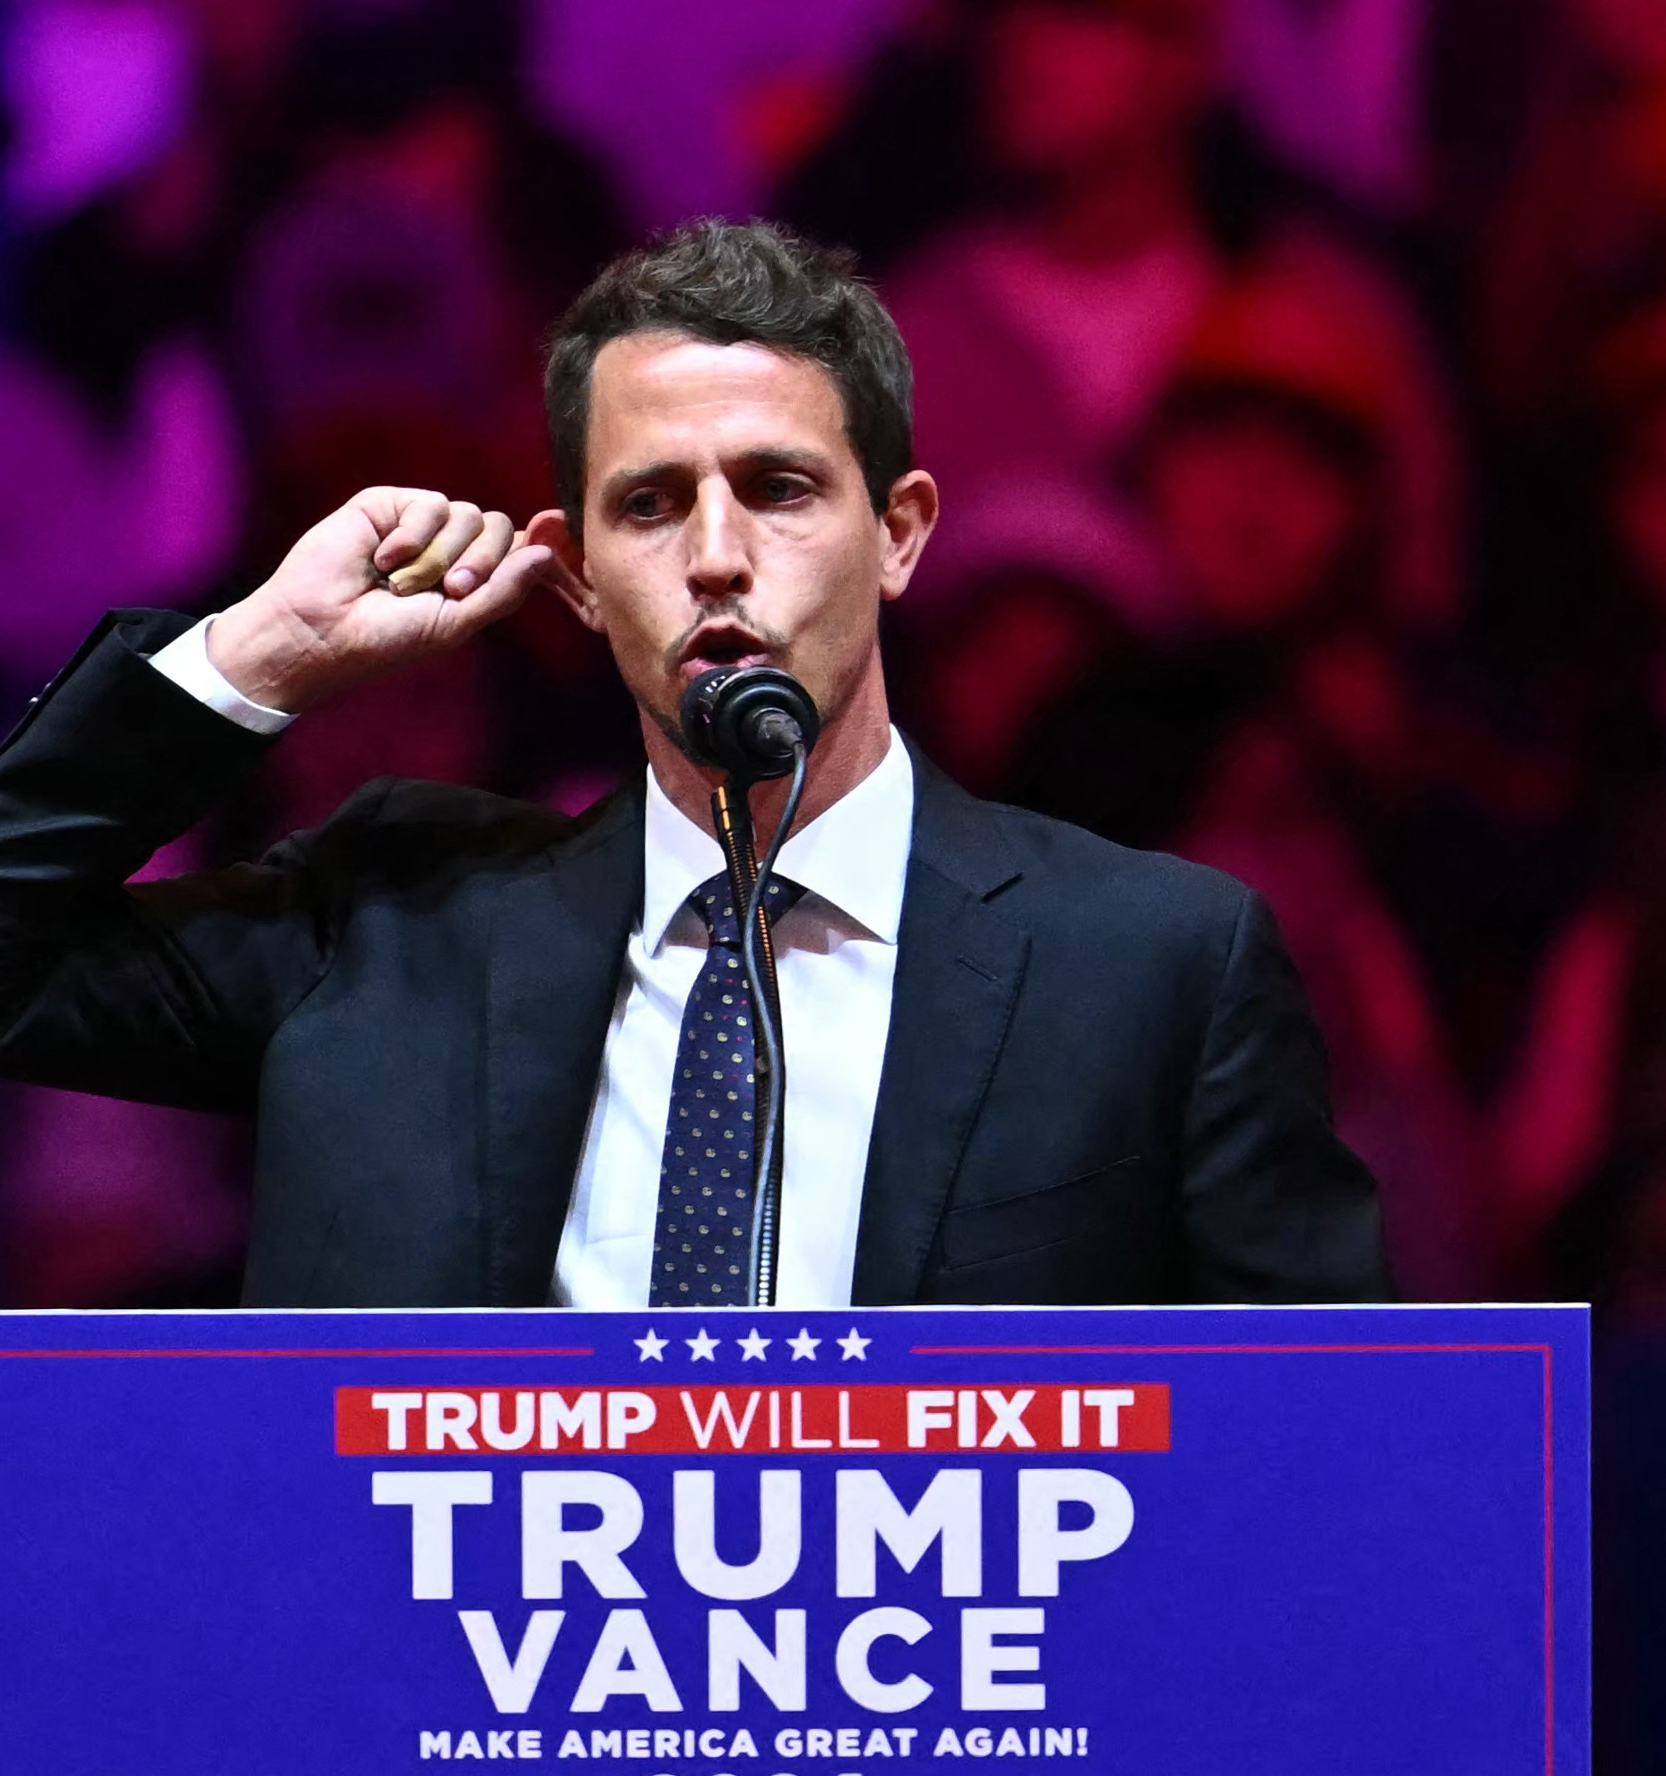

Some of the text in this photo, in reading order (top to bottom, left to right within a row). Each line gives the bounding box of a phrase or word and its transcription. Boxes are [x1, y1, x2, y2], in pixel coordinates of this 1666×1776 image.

[371, 1389, 1135, 1451] TRUMP WILL FIX IT
[371, 1468, 1135, 1601] TRUMP
[457, 1606, 1046, 1714] VANCE
[419, 1727, 1088, 1760] MAKE AMERICA GREAT AGAIN!
